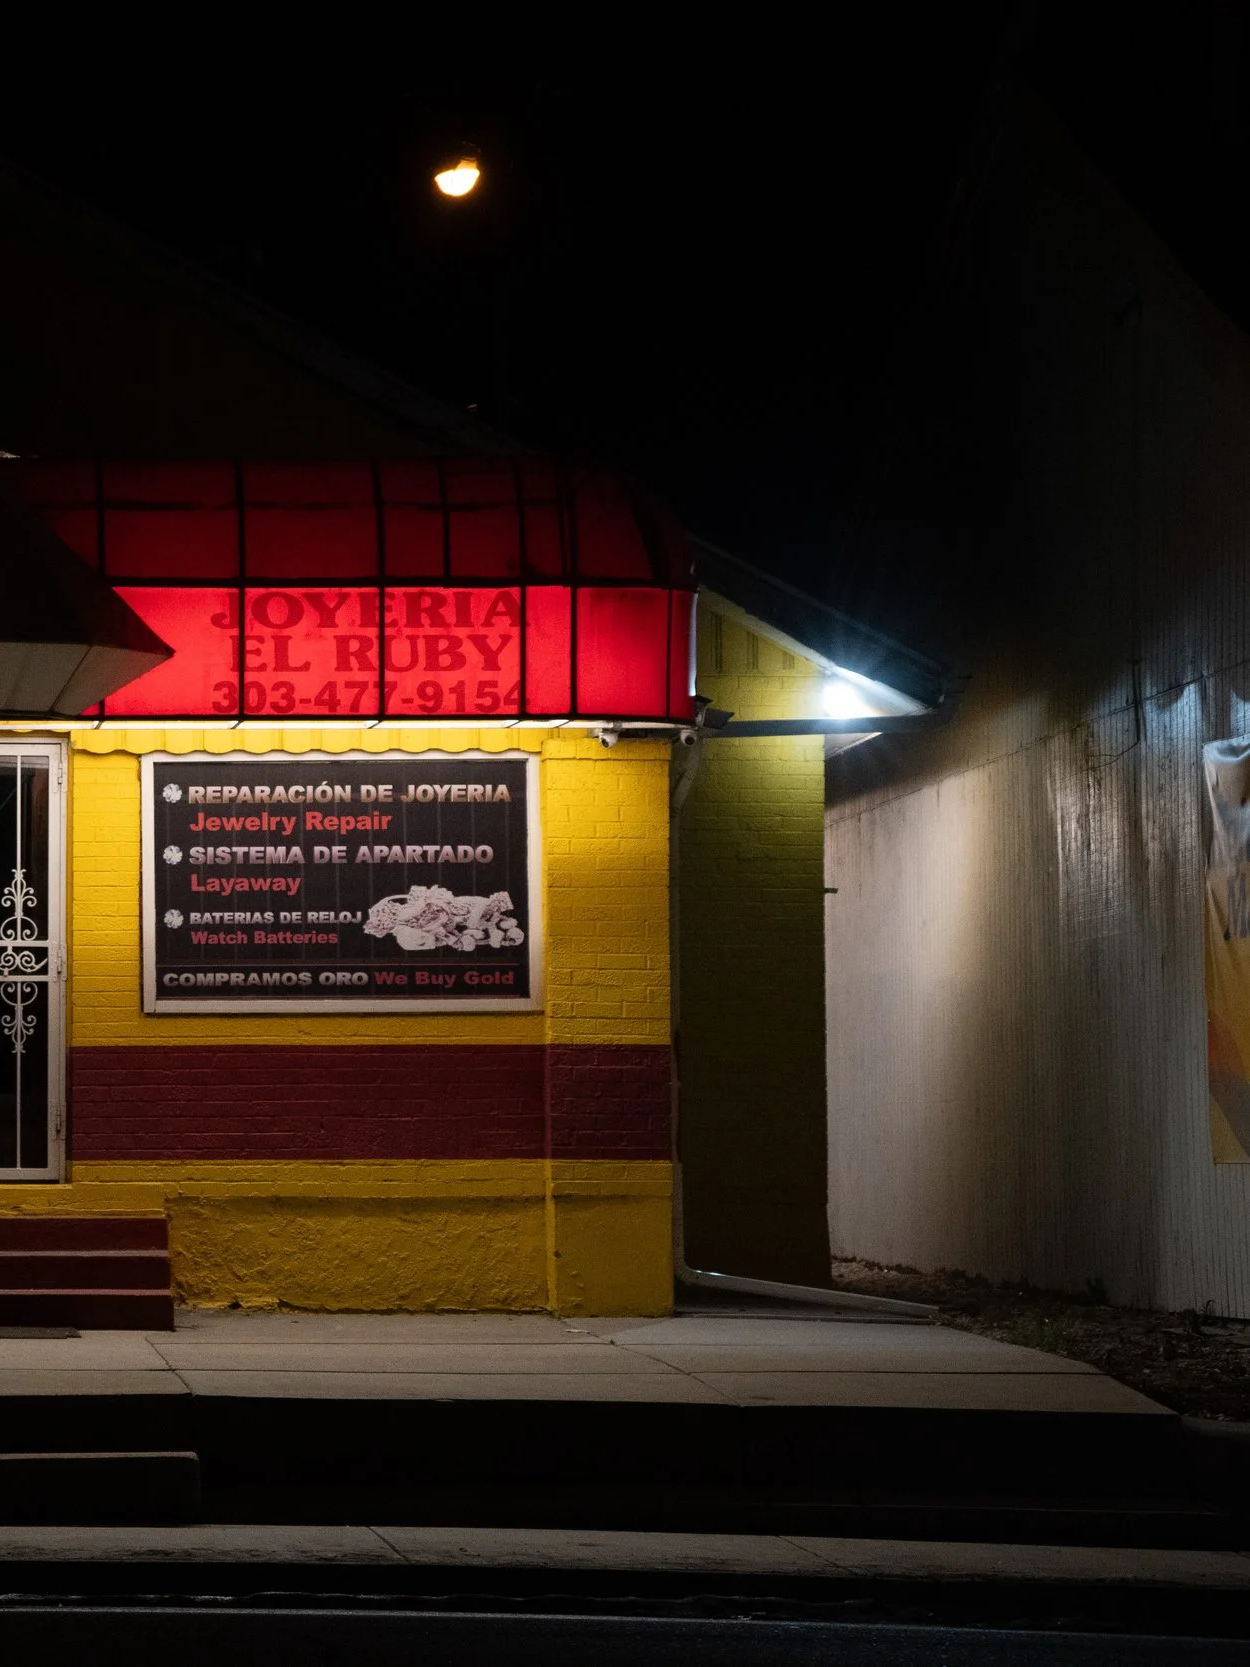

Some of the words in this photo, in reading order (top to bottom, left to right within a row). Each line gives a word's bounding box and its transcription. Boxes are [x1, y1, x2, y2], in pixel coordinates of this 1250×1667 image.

[210, 590, 529, 629] JOYERIA
[230, 634, 311, 672] EL
[333, 634, 513, 672] RUBY
[212, 680, 530, 714] 303-477-9154
[188, 781, 351, 804] REPARACIÓN
[361, 784, 393, 803] DE
[401, 784, 512, 803] JOYERIA
[190, 812, 297, 836] Jewelry
[305, 812, 392, 835] Repair
[189, 845, 305, 865] SISTEMA
[314, 845, 347, 864] DE
[354, 844, 494, 864] APARTADO
[191, 873, 301, 896] Layaway
[189, 911, 273, 925] BATERIAS
[280, 911, 302, 924] DE
[308, 911, 362, 925] RELOJ
[191, 931, 248, 945] Watch
[254, 931, 338, 945] Batteries
[163, 971, 312, 987] COMPRAMOS
[318, 971, 369, 987] ORO
[374, 971, 408, 986] We
[416, 971, 457, 988] Buy
[463, 970, 515, 986] Gold
